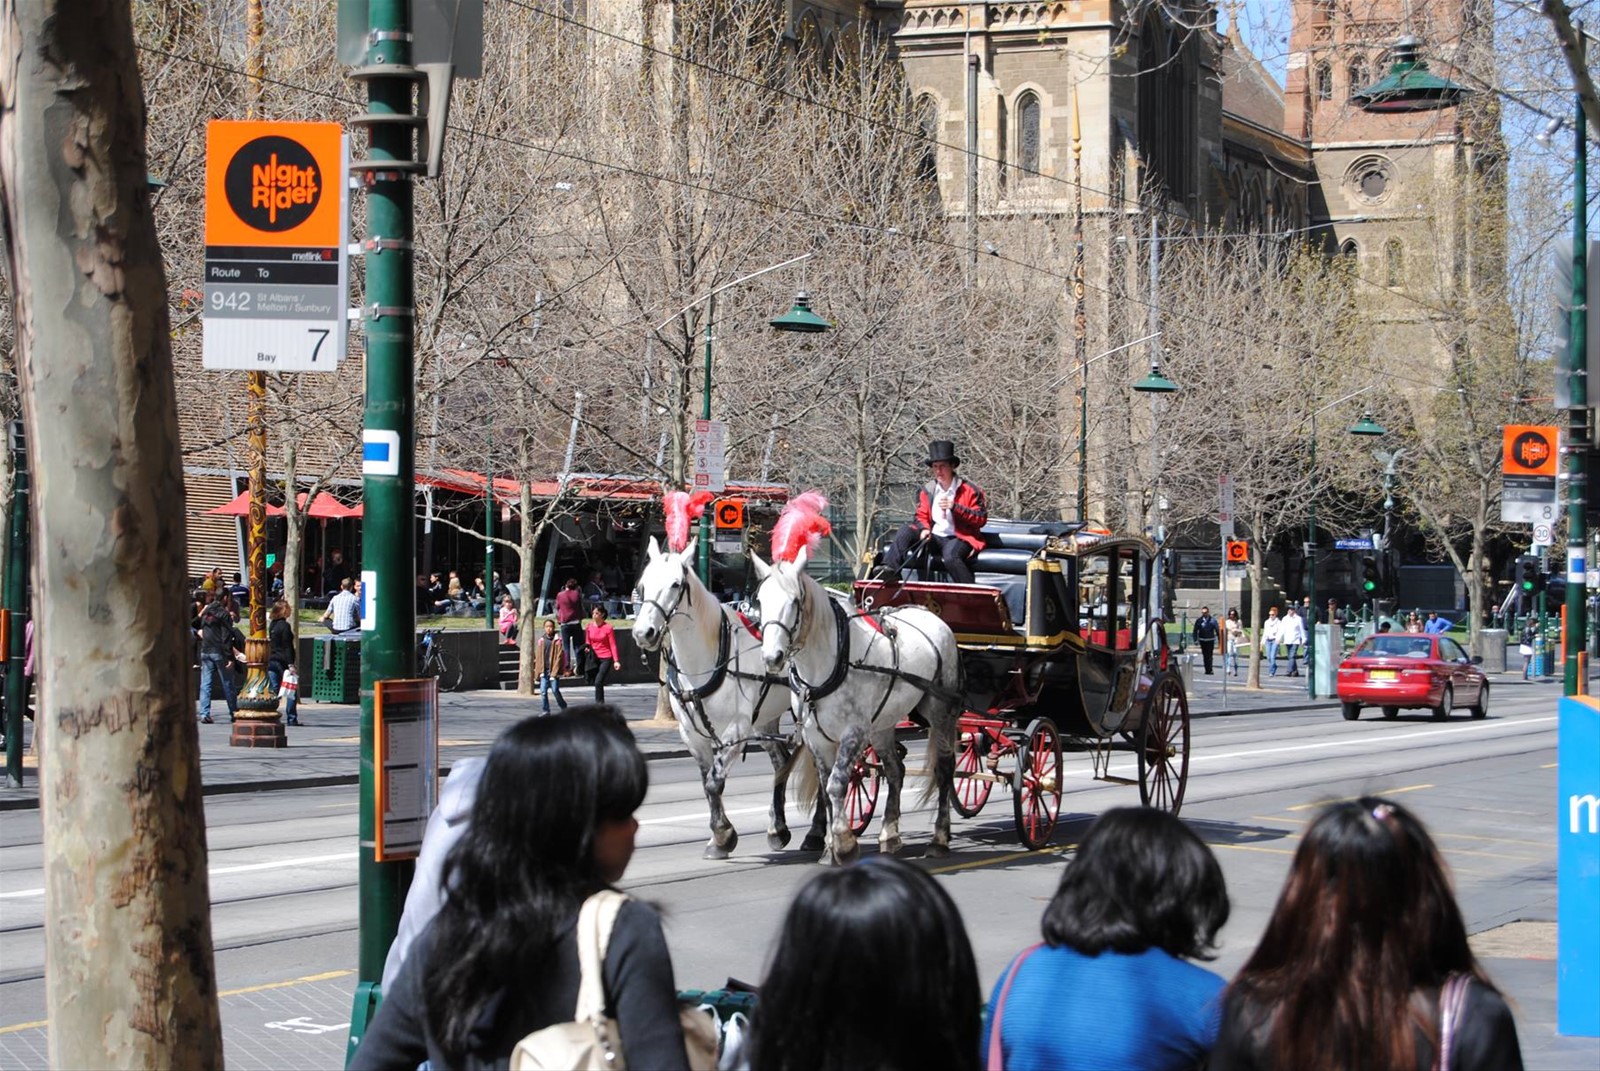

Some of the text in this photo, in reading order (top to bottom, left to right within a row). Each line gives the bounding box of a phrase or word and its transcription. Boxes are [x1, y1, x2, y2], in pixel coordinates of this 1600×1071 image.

[252, 152, 315, 188] Night
[252, 184, 318, 224] Rider
[291, 251, 322, 261] metlink
[211, 267, 270, 279] Route To
[211, 291, 251, 311] 942
[257, 293, 267, 302] St
[269, 293, 299, 303] Albans
[257, 303, 287, 311] Melton
[294, 304, 331, 314] Sunbury
[257, 328, 331, 363] Bay 7
[1542, 505, 1552, 520] 8
[1536, 529, 1548, 538] 30
